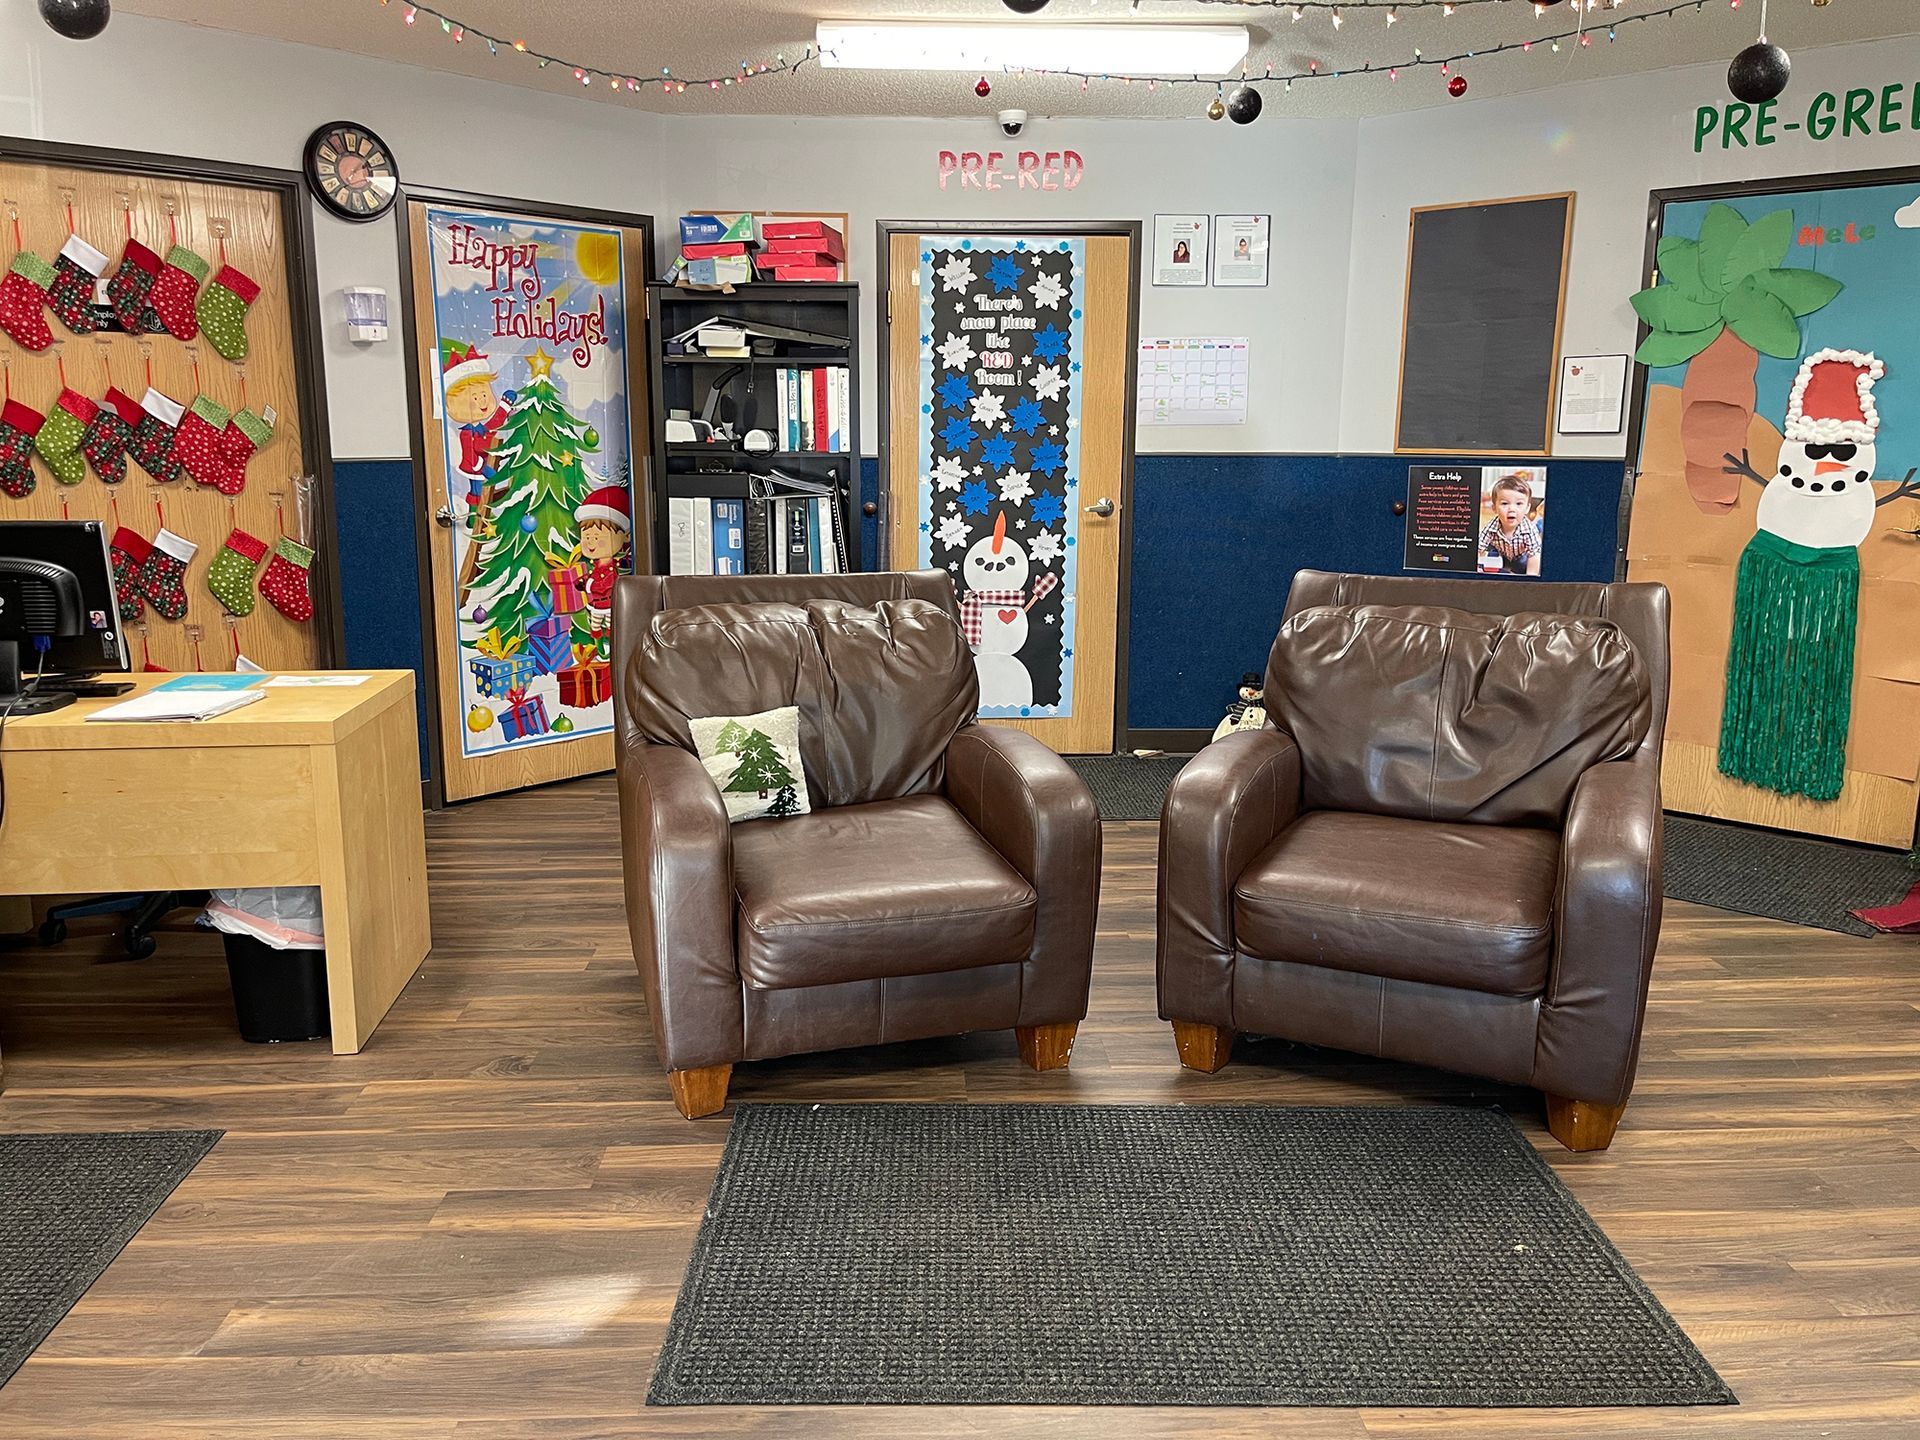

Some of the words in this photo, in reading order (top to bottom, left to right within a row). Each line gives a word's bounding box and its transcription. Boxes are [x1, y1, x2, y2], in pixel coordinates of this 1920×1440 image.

[939, 150, 1083, 191] PRE-RED
[447, 224, 541, 299] Happy
[973, 294, 1023, 311] There's
[490, 294, 609, 368] Holidays!
[960, 317, 996, 330] snow
[1000, 314, 1037, 334] place
[985, 332, 1011, 349] like
[979, 351, 1014, 368] RED
[1446, 472, 1462, 482] Help
